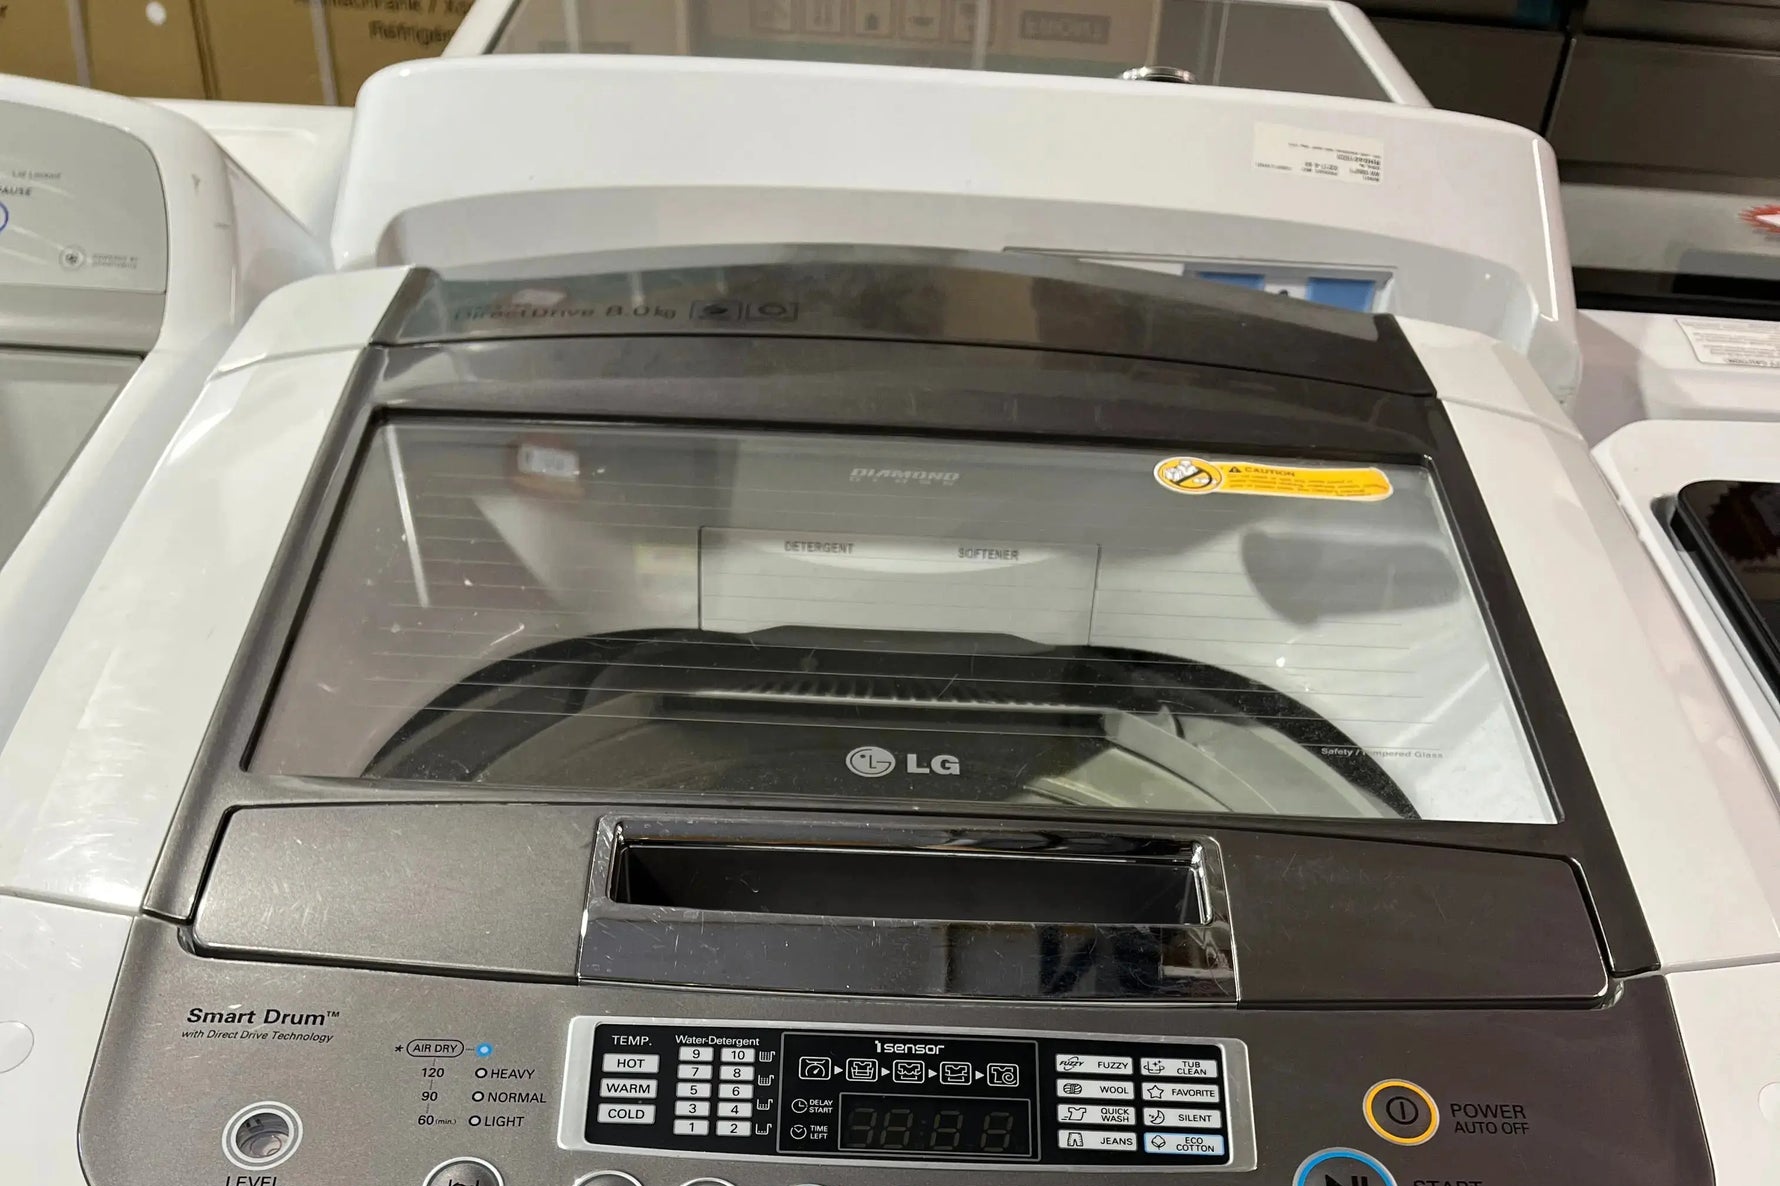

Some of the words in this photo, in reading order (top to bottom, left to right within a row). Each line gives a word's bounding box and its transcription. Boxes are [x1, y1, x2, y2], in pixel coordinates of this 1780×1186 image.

[849, 468, 960, 481] DIAMOND
[1244, 466, 1295, 477] CAUTION
[784, 540, 854, 554] DETERGENT
[958, 547, 1020, 561] SOFTENER
[1321, 747, 1353, 757] Safety
[906, 753, 960, 775] LG
[186, 1007, 257, 1024] Smart
[181, 1029, 205, 1039] with
[206, 1029, 239, 1040] Direct
[240, 1030, 269, 1041] Drive
[271, 1031, 334, 1043] Technology
[612, 1035, 653, 1047] TEMP.
[412, 1044, 432, 1054] AIR
[434, 1044, 459, 1054] DRY
[692, 1048, 701, 1060] 9
[731, 1050, 746, 1062] 10
[617, 1058, 645, 1069] HOT
[1097, 1061, 1129, 1070] FUZZY
[1182, 1060, 1201, 1069] TUB
[421, 1067, 445, 1079] 120
[490, 1069, 535, 1080] HEAVY
[691, 1066, 700, 1077] 7
[732, 1067, 742, 1079] 8
[1176, 1067, 1207, 1076] CLEAN
[606, 1083, 650, 1095] WARM
[689, 1084, 698, 1096] 5
[732, 1085, 741, 1097] 6
[1099, 1085, 1129, 1095] WOOL
[1171, 1088, 1215, 1098] FAVORITE
[421, 1091, 439, 1103] 90
[487, 1092, 547, 1104] NORMAL
[809, 1099, 834, 1107] DELAY
[608, 1108, 645, 1120] COLD
[688, 1102, 697, 1115] 3
[730, 1103, 740, 1116] 4
[808, 1106, 833, 1114] START
[1100, 1107, 1129, 1116] QUICK
[1450, 1103, 1527, 1120] POWER
[484, 1116, 525, 1128] LIGHT
[1100, 1114, 1130, 1123] WASH
[1178, 1113, 1212, 1123] SILENT
[688, 1121, 695, 1133] 1
[730, 1122, 739, 1134] 2
[810, 1125, 829, 1133] TIME
[1454, 1121, 1498, 1135] AUTO
[1501, 1122, 1530, 1136] OFF
[809, 1132, 828, 1140] LEFT
[1100, 1136, 1133, 1146] JEANS
[1184, 1136, 1204, 1145] ECO
[1175, 1143, 1215, 1153] COTTON
